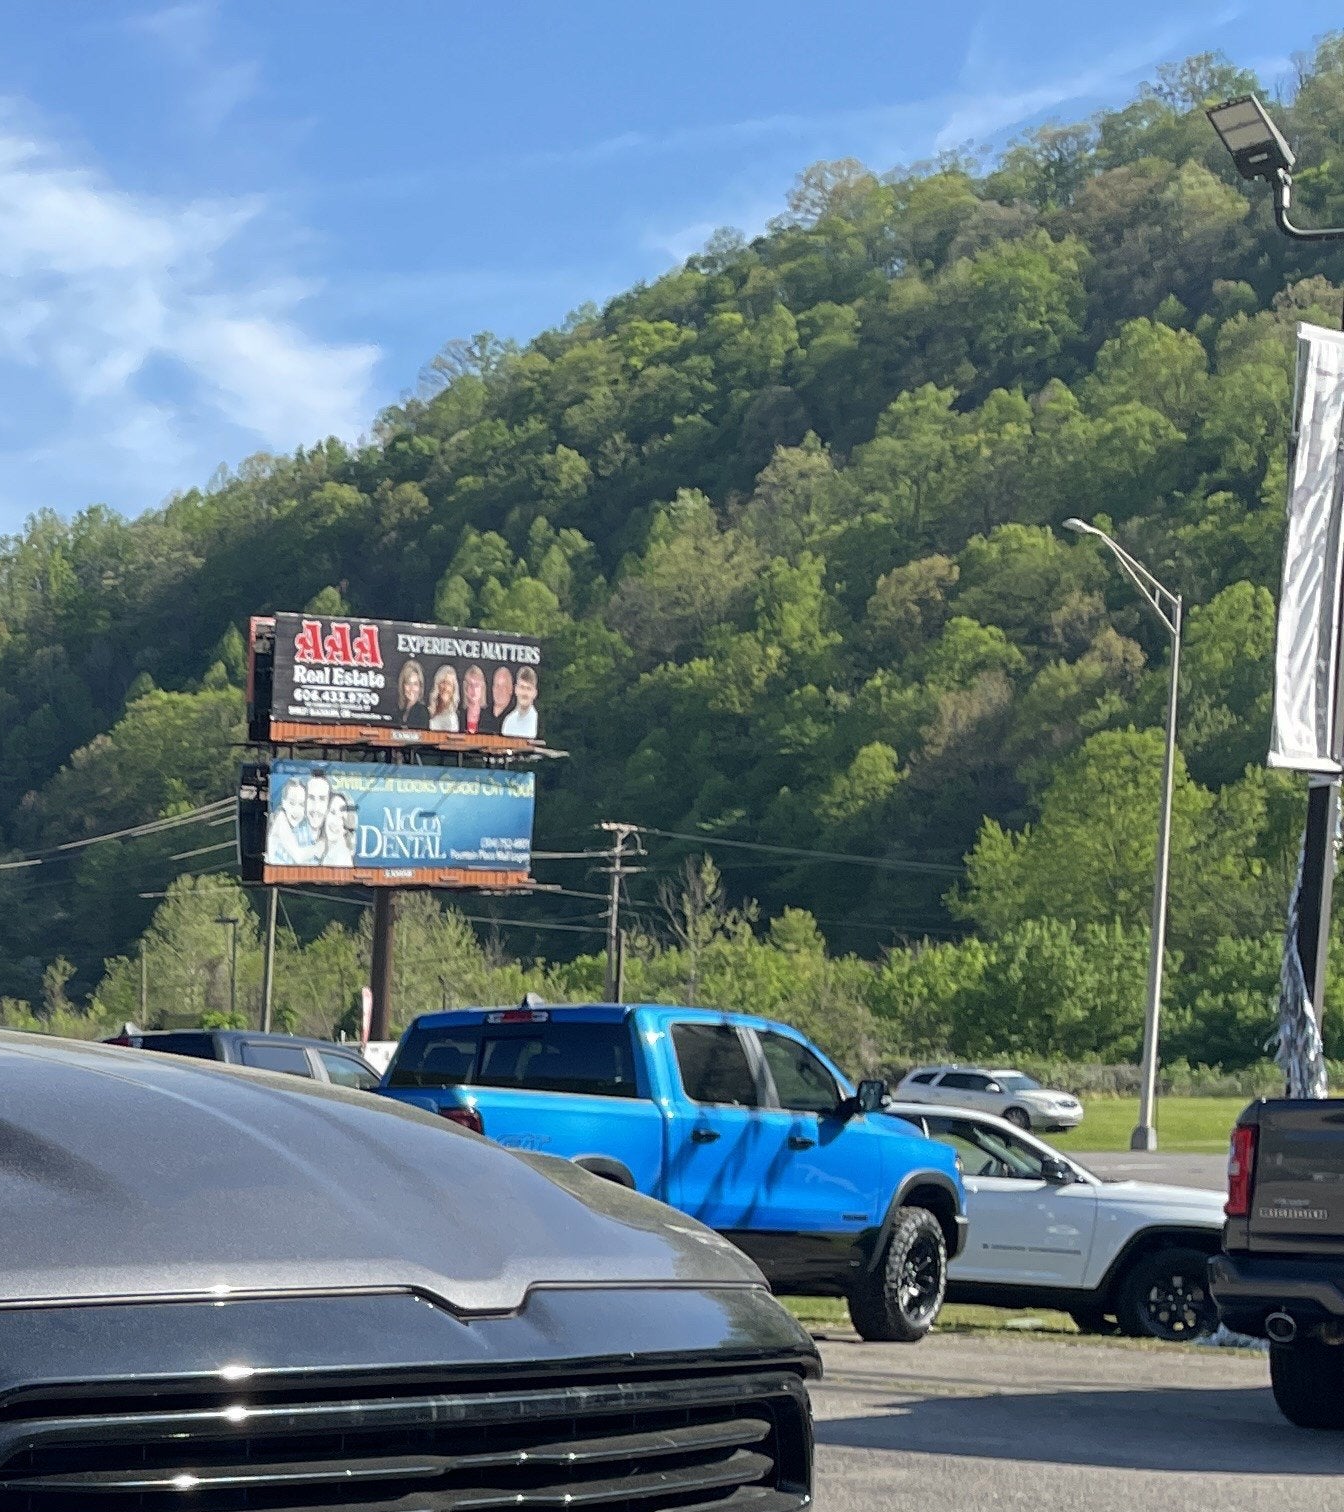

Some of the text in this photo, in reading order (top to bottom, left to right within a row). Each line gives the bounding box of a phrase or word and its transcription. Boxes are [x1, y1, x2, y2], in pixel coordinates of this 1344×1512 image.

[294, 620, 384, 669] AAA
[397, 633, 541, 665] EXPERIENCE MATTERS
[293, 664, 385, 689] Real Estate
